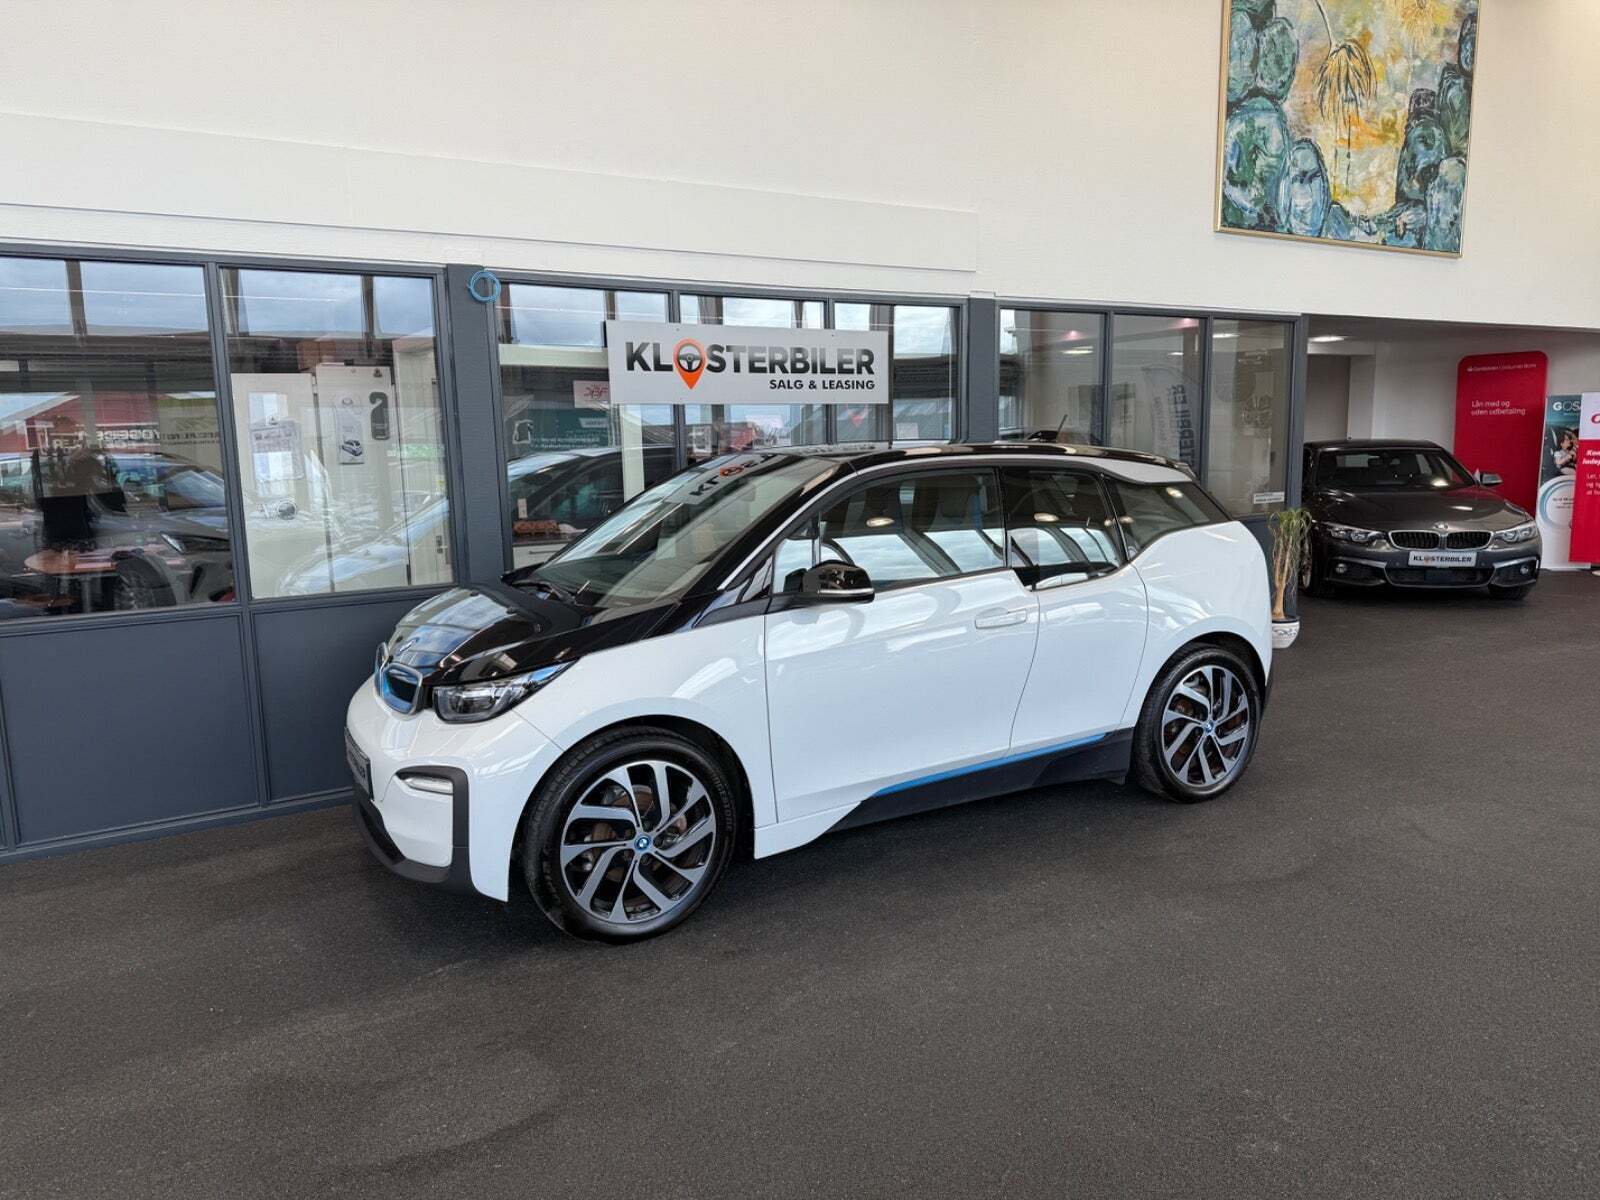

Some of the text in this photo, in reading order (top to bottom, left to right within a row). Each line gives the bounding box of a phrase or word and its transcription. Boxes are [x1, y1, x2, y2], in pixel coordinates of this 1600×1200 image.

[625, 339, 875, 377] KLOSTERBILER
[769, 379, 875, 390] SALG & LEASING
[1553, 400, 1581, 411] GOS
